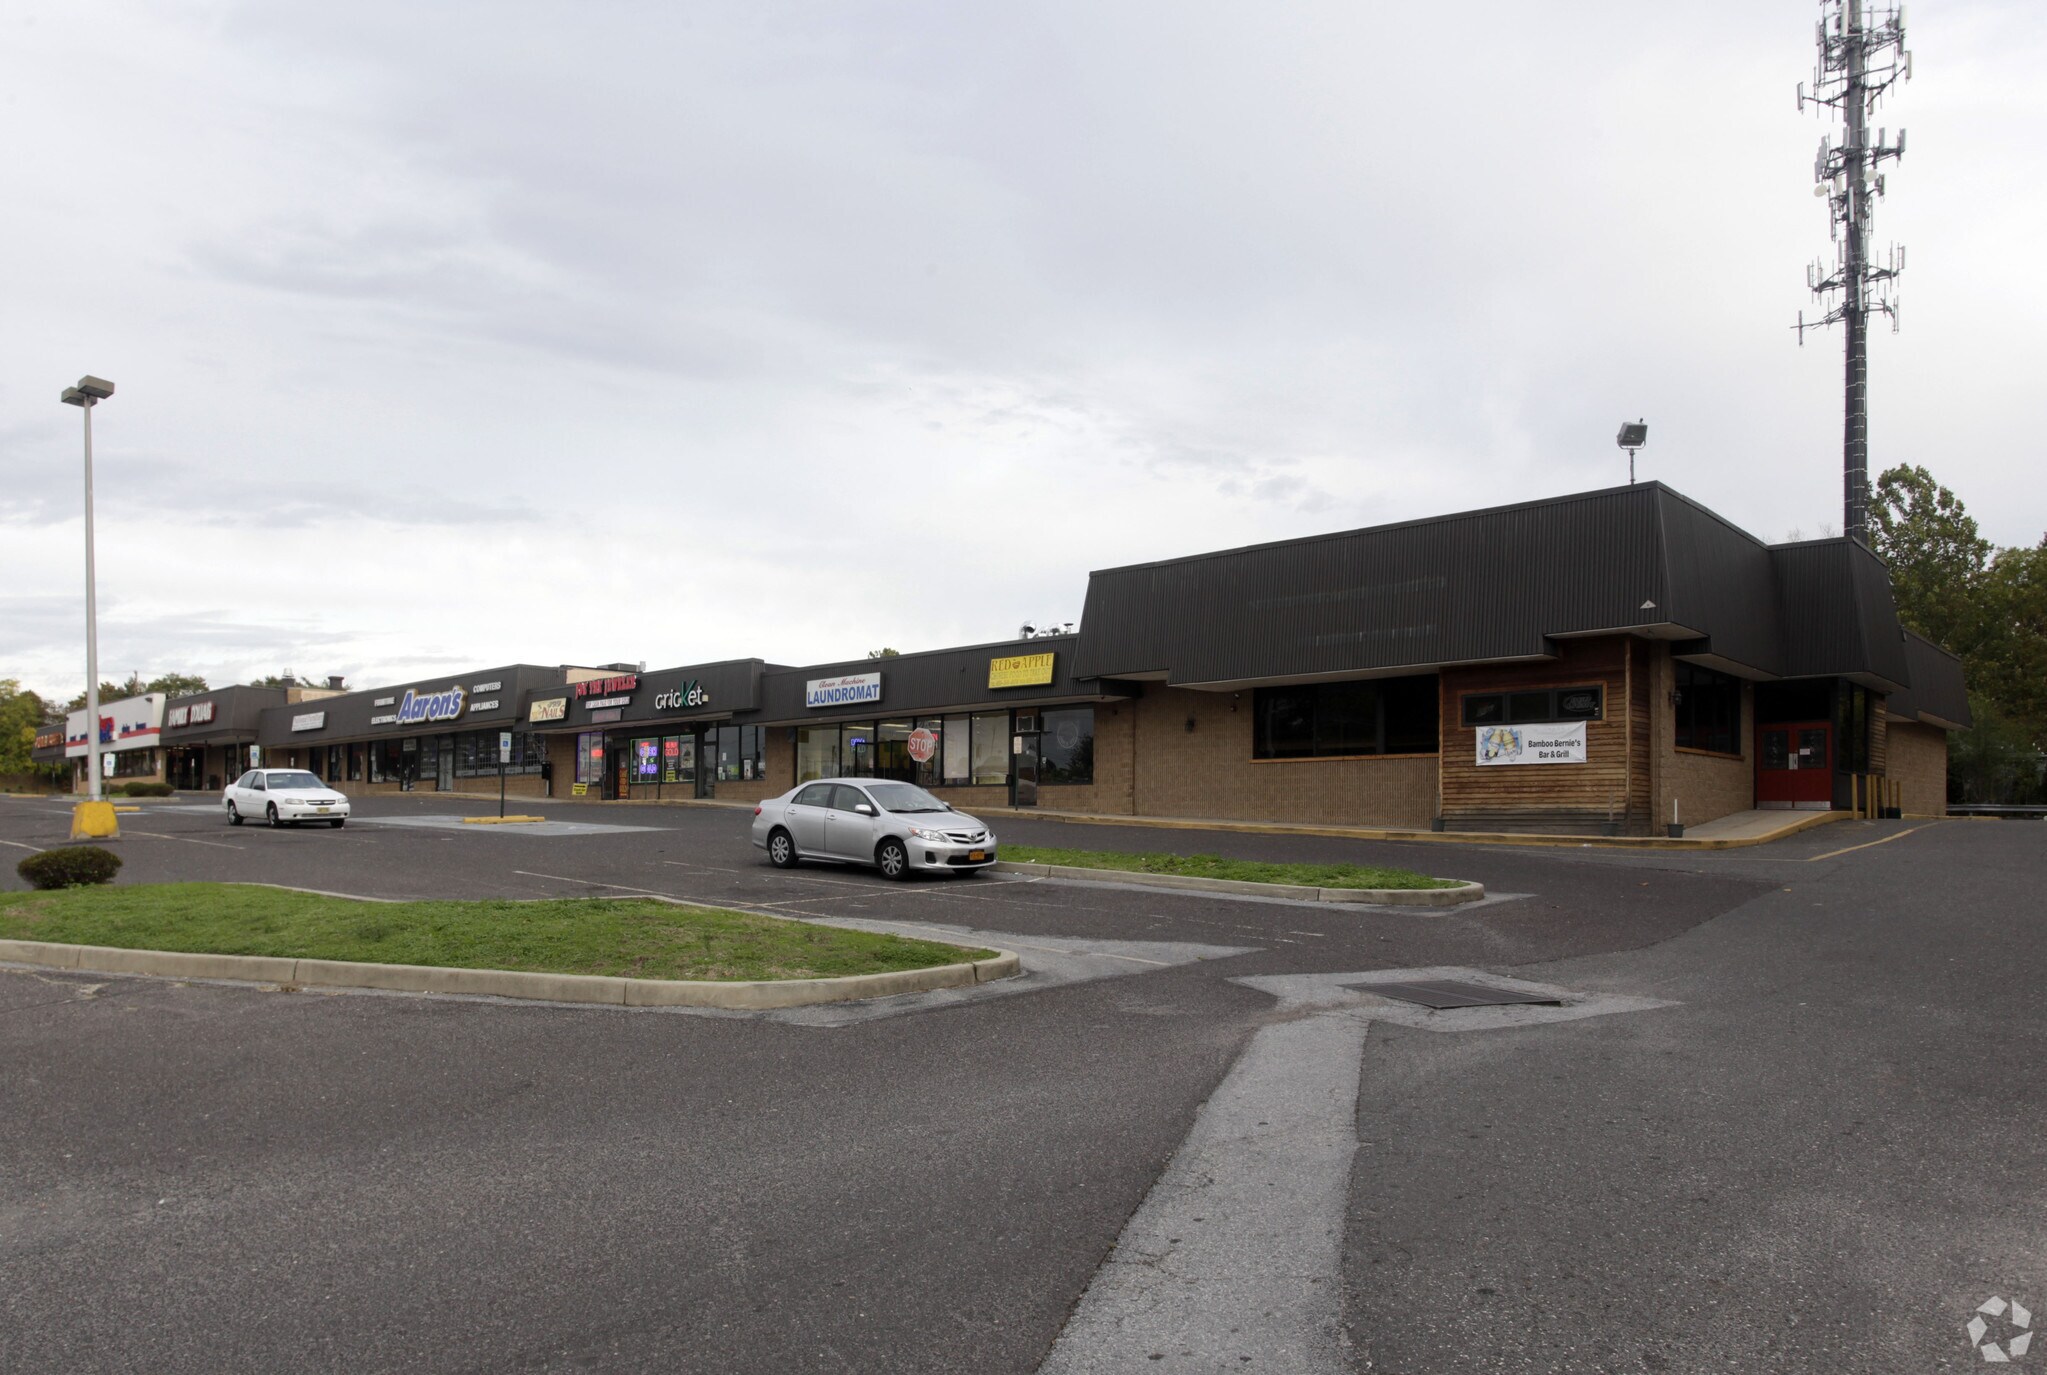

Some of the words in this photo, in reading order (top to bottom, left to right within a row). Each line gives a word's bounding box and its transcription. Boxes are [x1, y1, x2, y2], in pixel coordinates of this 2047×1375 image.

[991, 658, 1012, 672] RED
[1021, 654, 1052, 669] APPLE
[472, 682, 501, 693] COMPUTERS
[807, 684, 880, 705] LAUNDROMAT
[396, 685, 465, 724] Aaron's
[469, 700, 499, 712] APPLIANCES
[541, 705, 565, 719] NAILS
[910, 737, 933, 752] STOP
[1528, 740, 1554, 748] Bamboo
[1554, 739, 1581, 748] Bernie's
[1538, 751, 1549, 759] Bar
[1556, 750, 1570, 758] Grill
